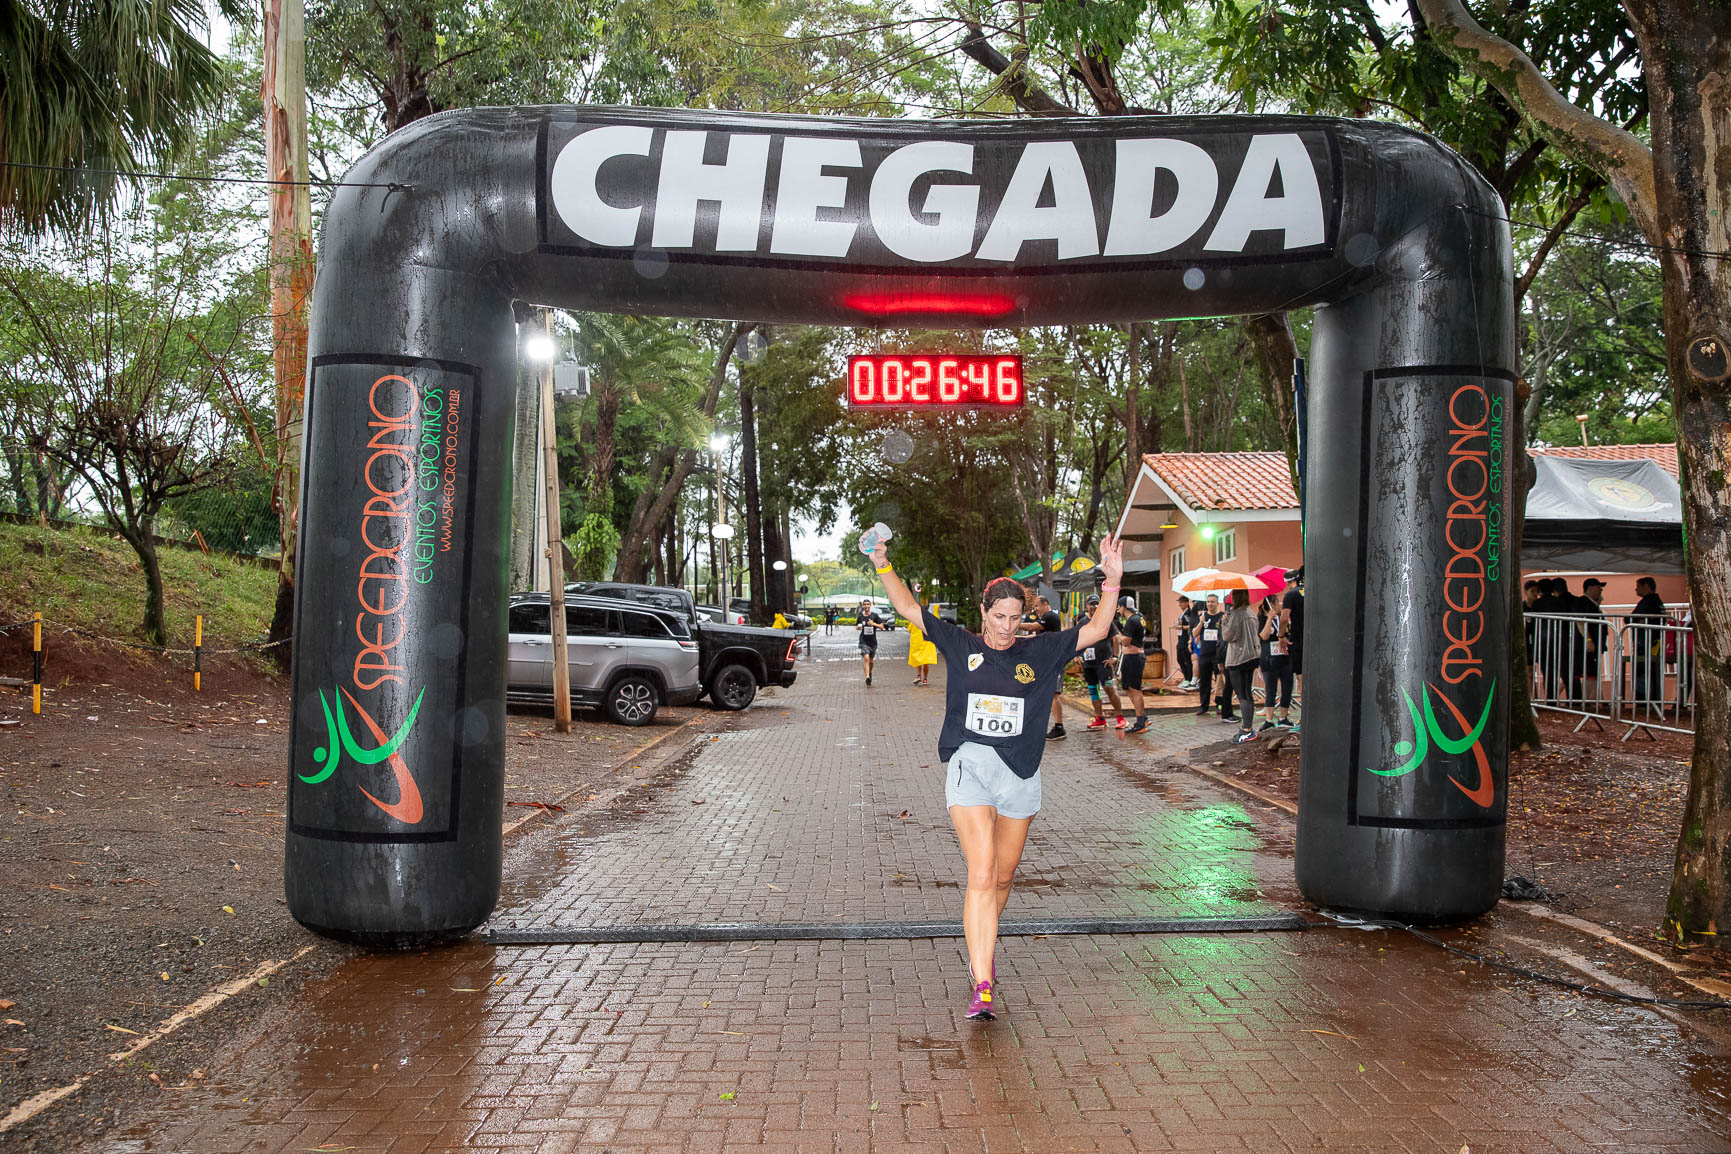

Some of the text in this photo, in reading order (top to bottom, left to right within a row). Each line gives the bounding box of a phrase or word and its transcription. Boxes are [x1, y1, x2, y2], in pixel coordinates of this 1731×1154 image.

[552, 125, 1325, 262] CHEGADA
[854, 360, 1017, 401] 00:26:46
[353, 374, 419, 690] SPEEDCRONO
[414, 385, 443, 584] EVENTOS ESPORTIVOS
[440, 389, 460, 552] WWW.SPEEDCRONO.COM.BR
[1441, 384, 1490, 685] SPEEDCRONO
[1487, 393, 1504, 582] EVENTOS ESPORTIVOS
[977, 718, 1013, 733] 100
